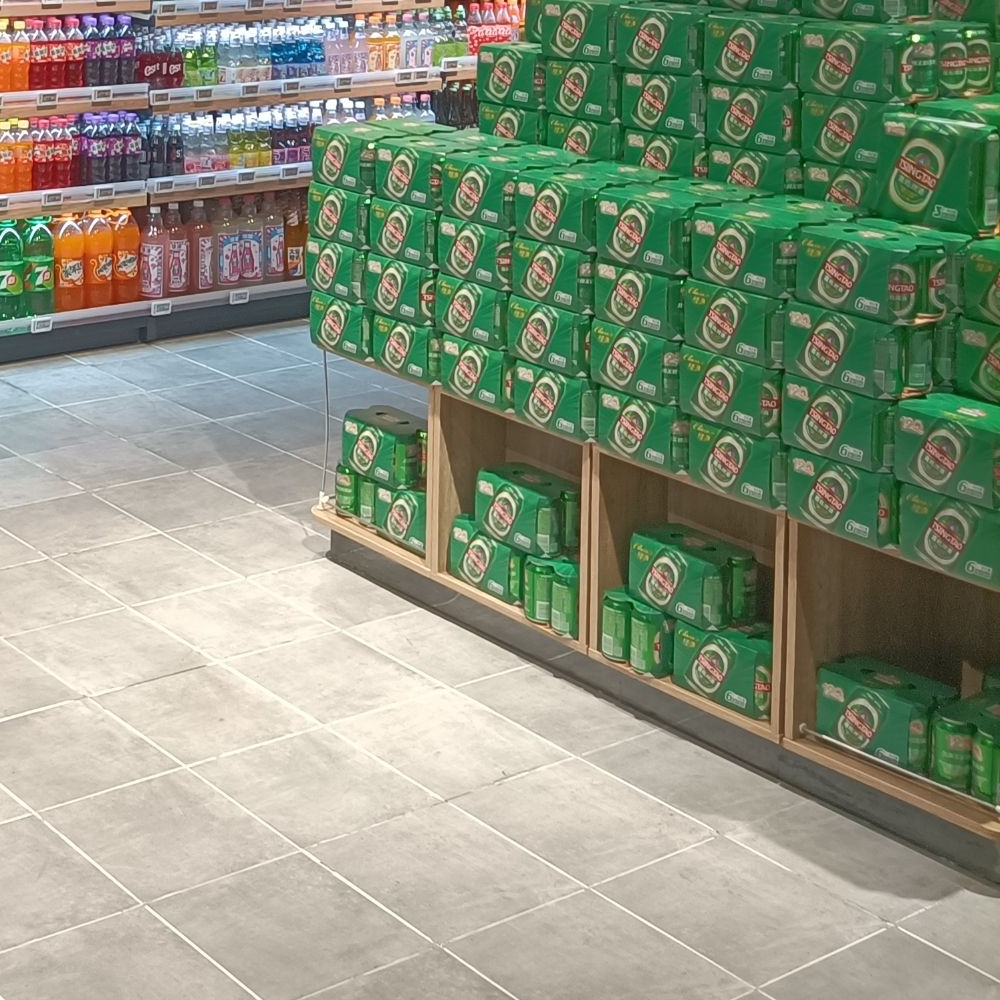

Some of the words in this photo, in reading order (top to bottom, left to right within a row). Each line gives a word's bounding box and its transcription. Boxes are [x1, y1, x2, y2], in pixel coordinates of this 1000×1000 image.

[900, 160, 938, 190] TSINGTAO
[716, 241, 742, 266] TSINGTAO
[824, 261, 853, 289] TSINGTAO
[709, 310, 734, 335] TSINGTAO
[811, 335, 840, 362] TSINGTAO
[703, 376, 729, 401] TSINGTAO
[809, 408, 837, 435] TSINGTAO
[714, 448, 739, 473] TSINGTAO
[925, 442, 955, 471] TSINGTAO
[815, 484, 843, 511] TSINGTAO
[932, 522, 963, 550] TSINGTAO
